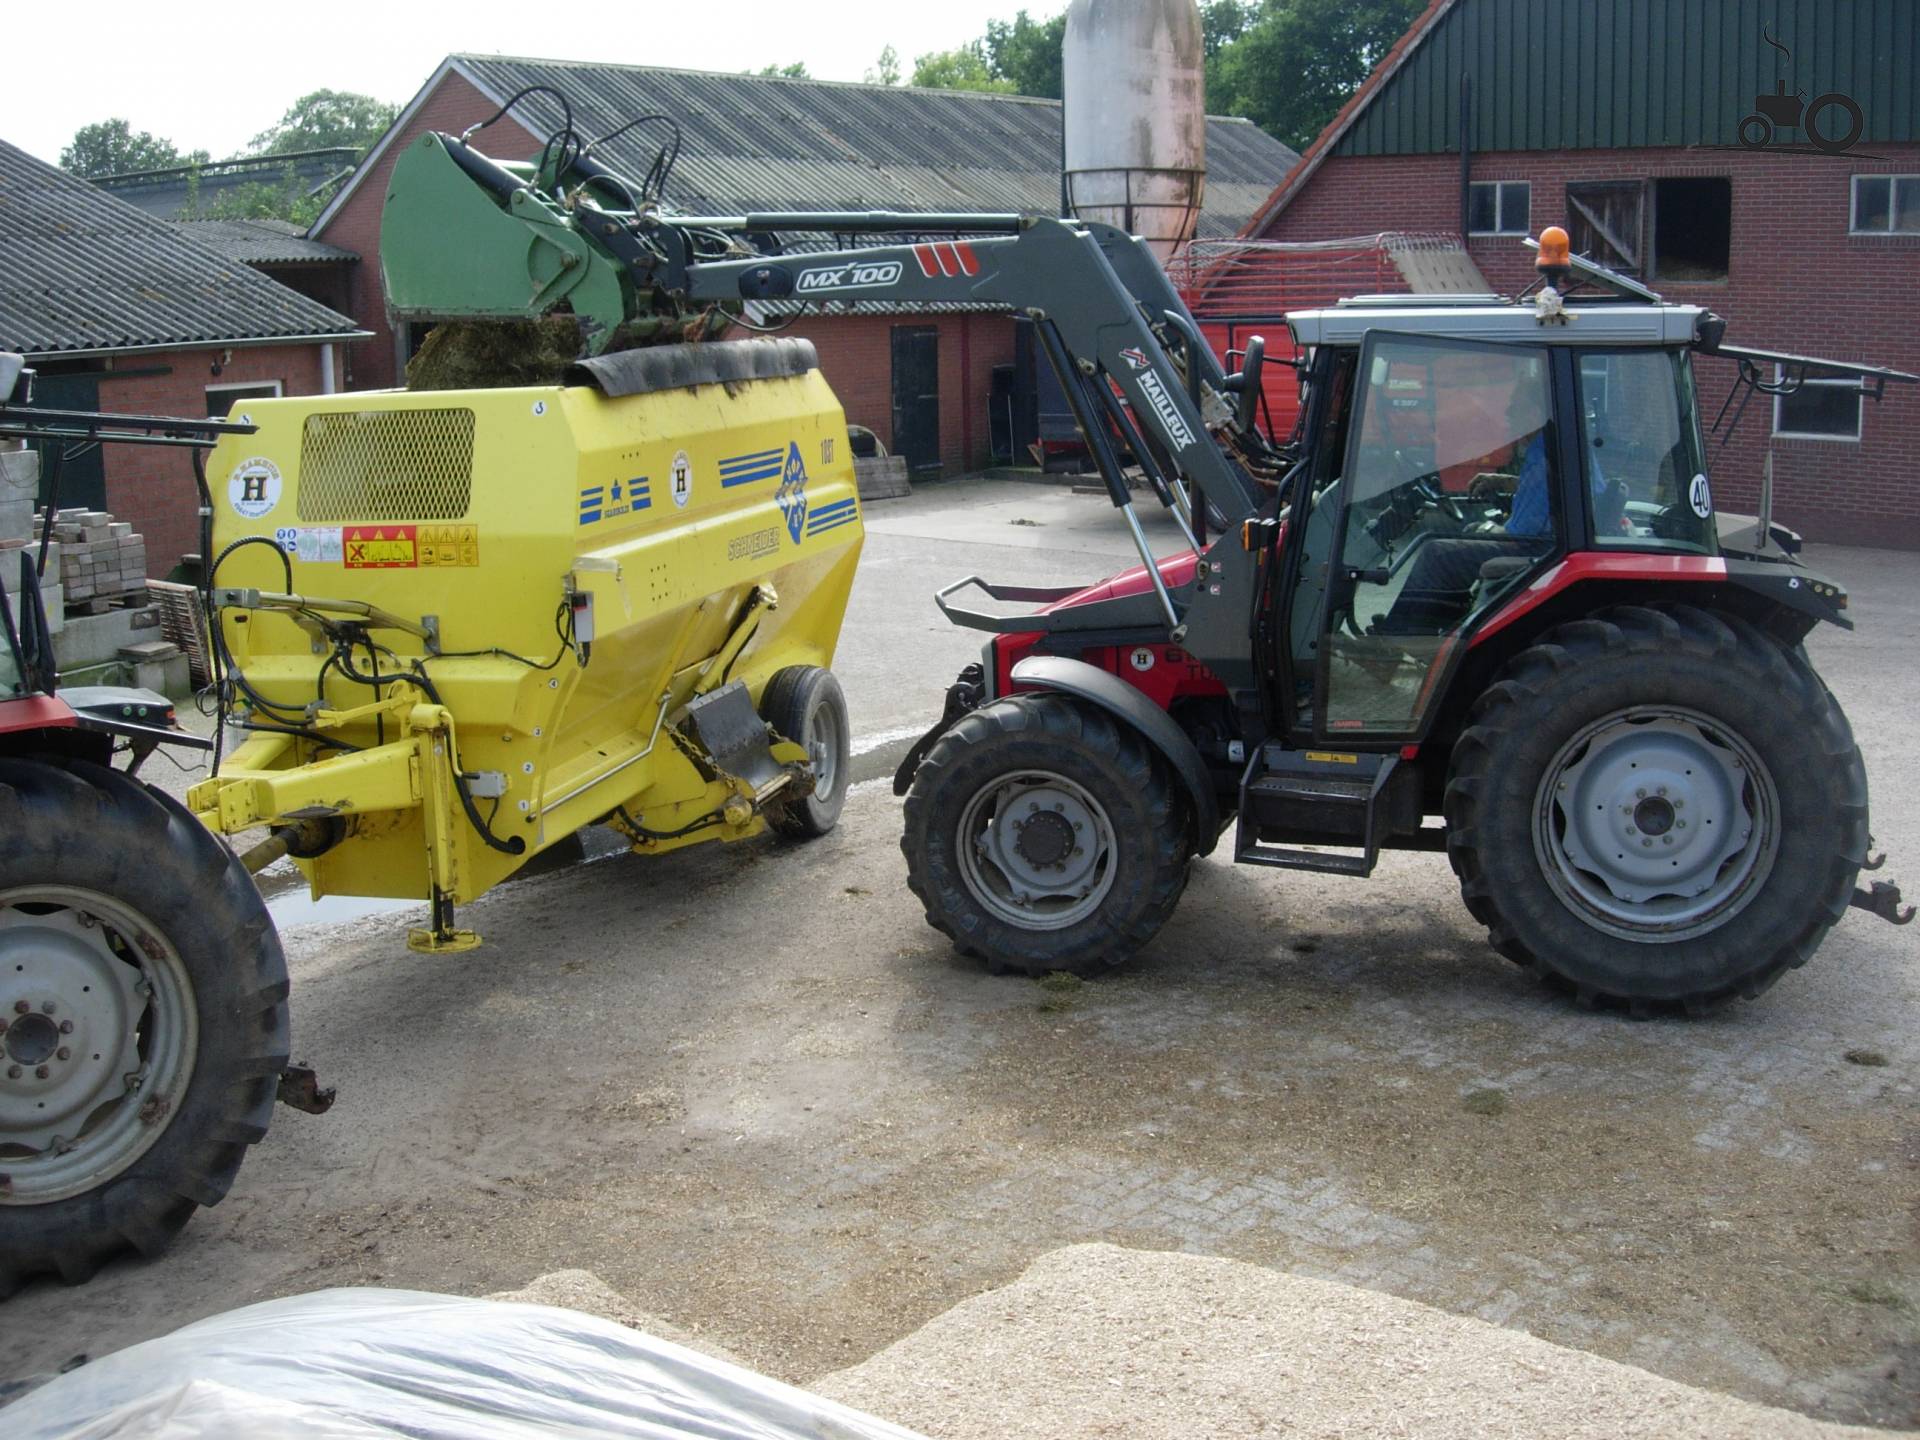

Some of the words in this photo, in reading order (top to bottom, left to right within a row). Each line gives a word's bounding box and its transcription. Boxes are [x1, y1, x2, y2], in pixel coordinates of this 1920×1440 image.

[1140, 371, 1193, 449] MAILLEUX
[241, 475, 267, 501] H
[676, 468, 686, 492] H
[1693, 480, 1709, 512] 40
[728, 526, 780, 561] SCHNEIDER
